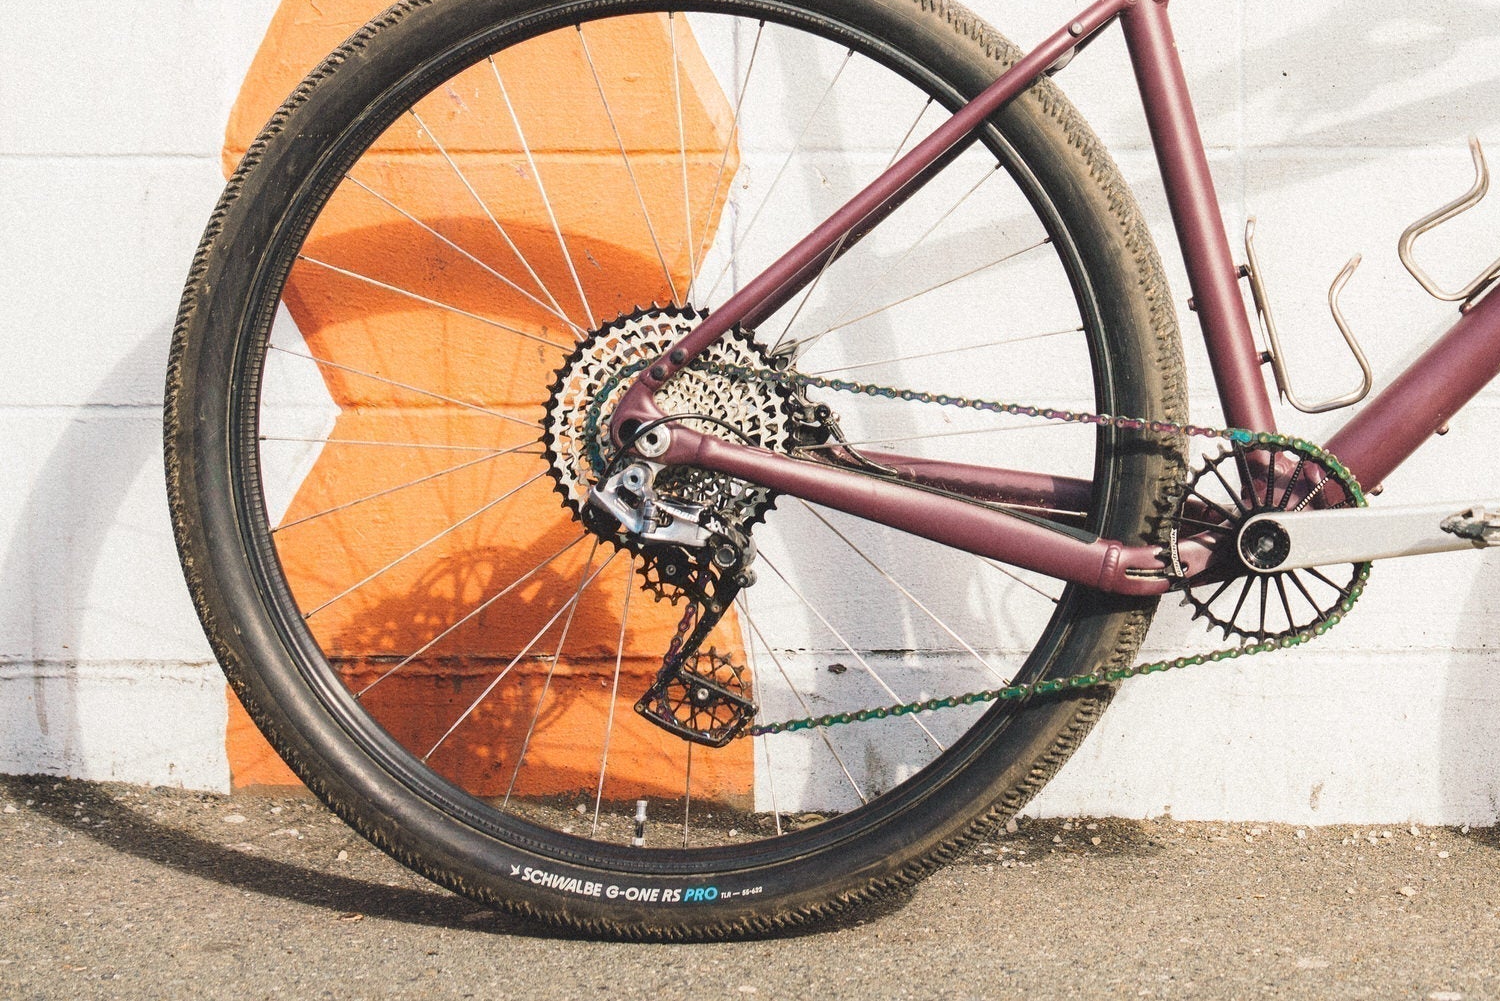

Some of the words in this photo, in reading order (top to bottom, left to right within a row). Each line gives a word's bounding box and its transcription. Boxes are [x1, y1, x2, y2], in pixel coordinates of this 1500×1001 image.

[521, 867, 602, 897] SCHWALBE
[605, 886, 659, 901] G-ONE
[661, 888, 682, 902] RS
[684, 886, 718, 901] PRO
[720, 891, 732, 899] TLR
